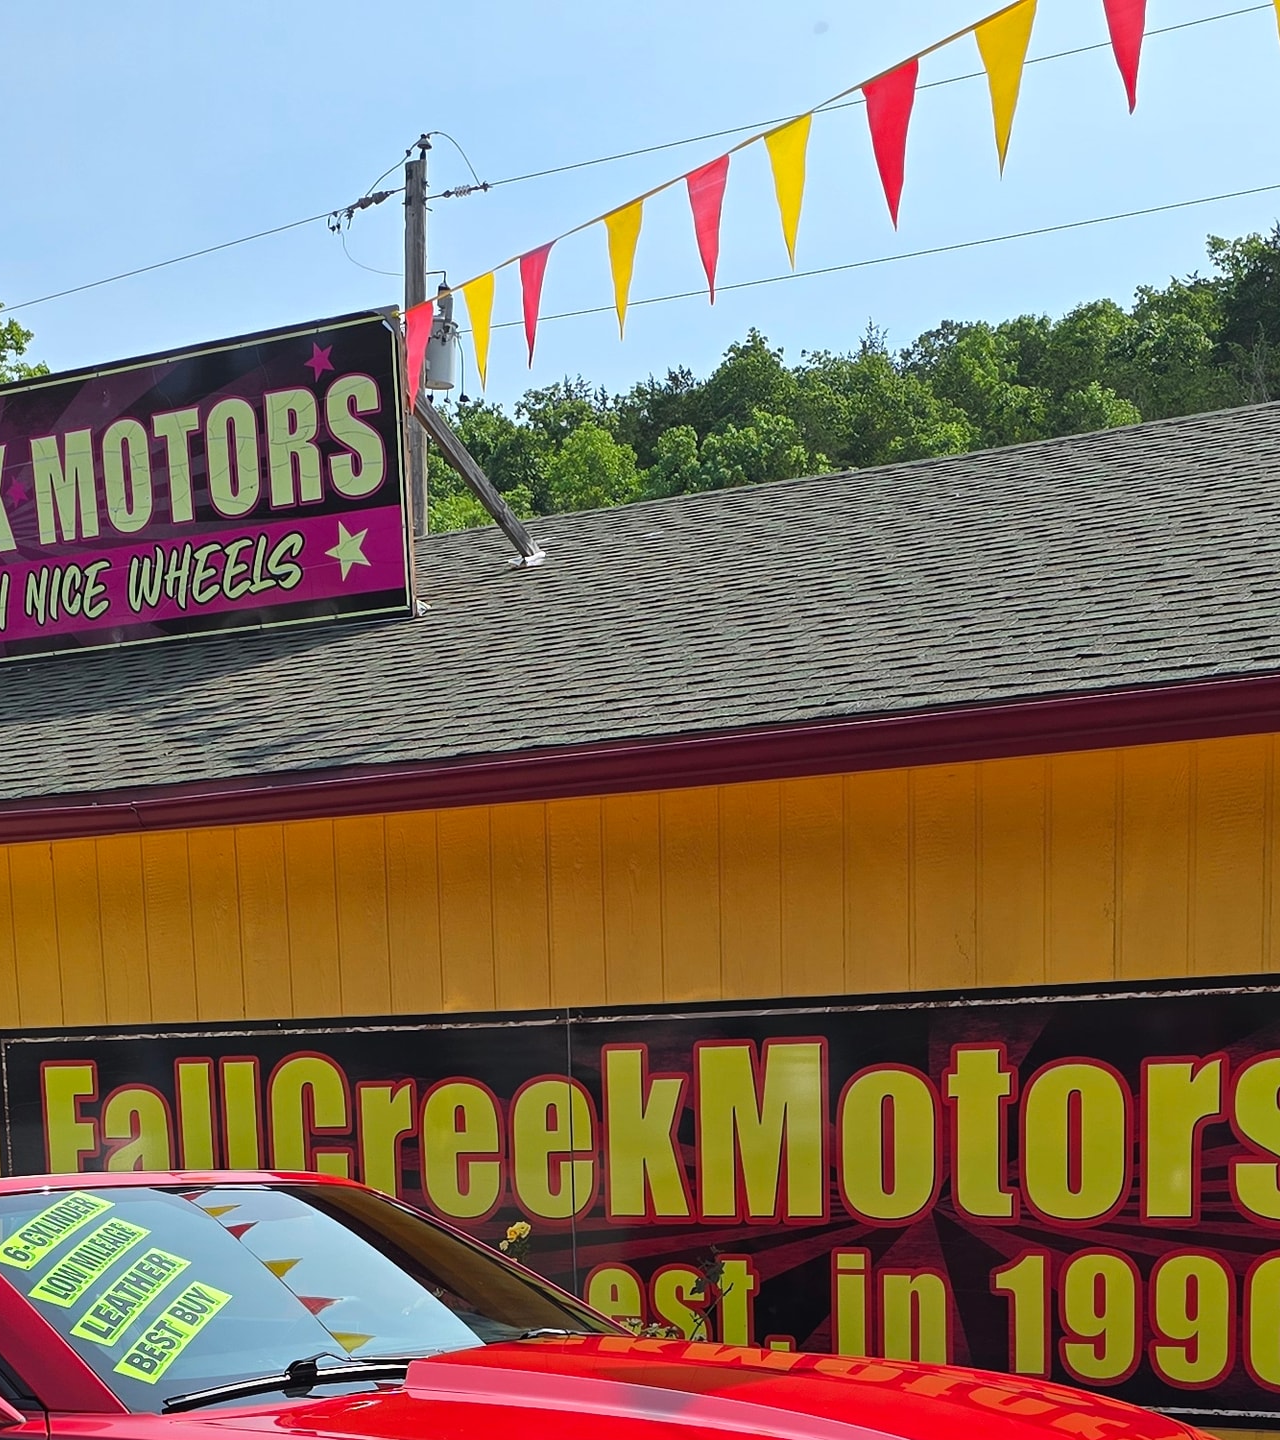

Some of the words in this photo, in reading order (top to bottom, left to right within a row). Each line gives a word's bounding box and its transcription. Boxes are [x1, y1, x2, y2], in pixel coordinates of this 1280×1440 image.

[28, 371, 387, 547] MOTORS
[23, 559, 111, 623] NICE
[127, 531, 308, 612] WHEELS
[39, 1261, 84, 1302] LOW
[78, 1220, 138, 1273] MILEAGE
[80, 1251, 179, 1341] LEATHER
[833, 1248, 949, 1367] in
[124, 1318, 187, 1378] BEST
[175, 1284, 221, 1329] BUY
